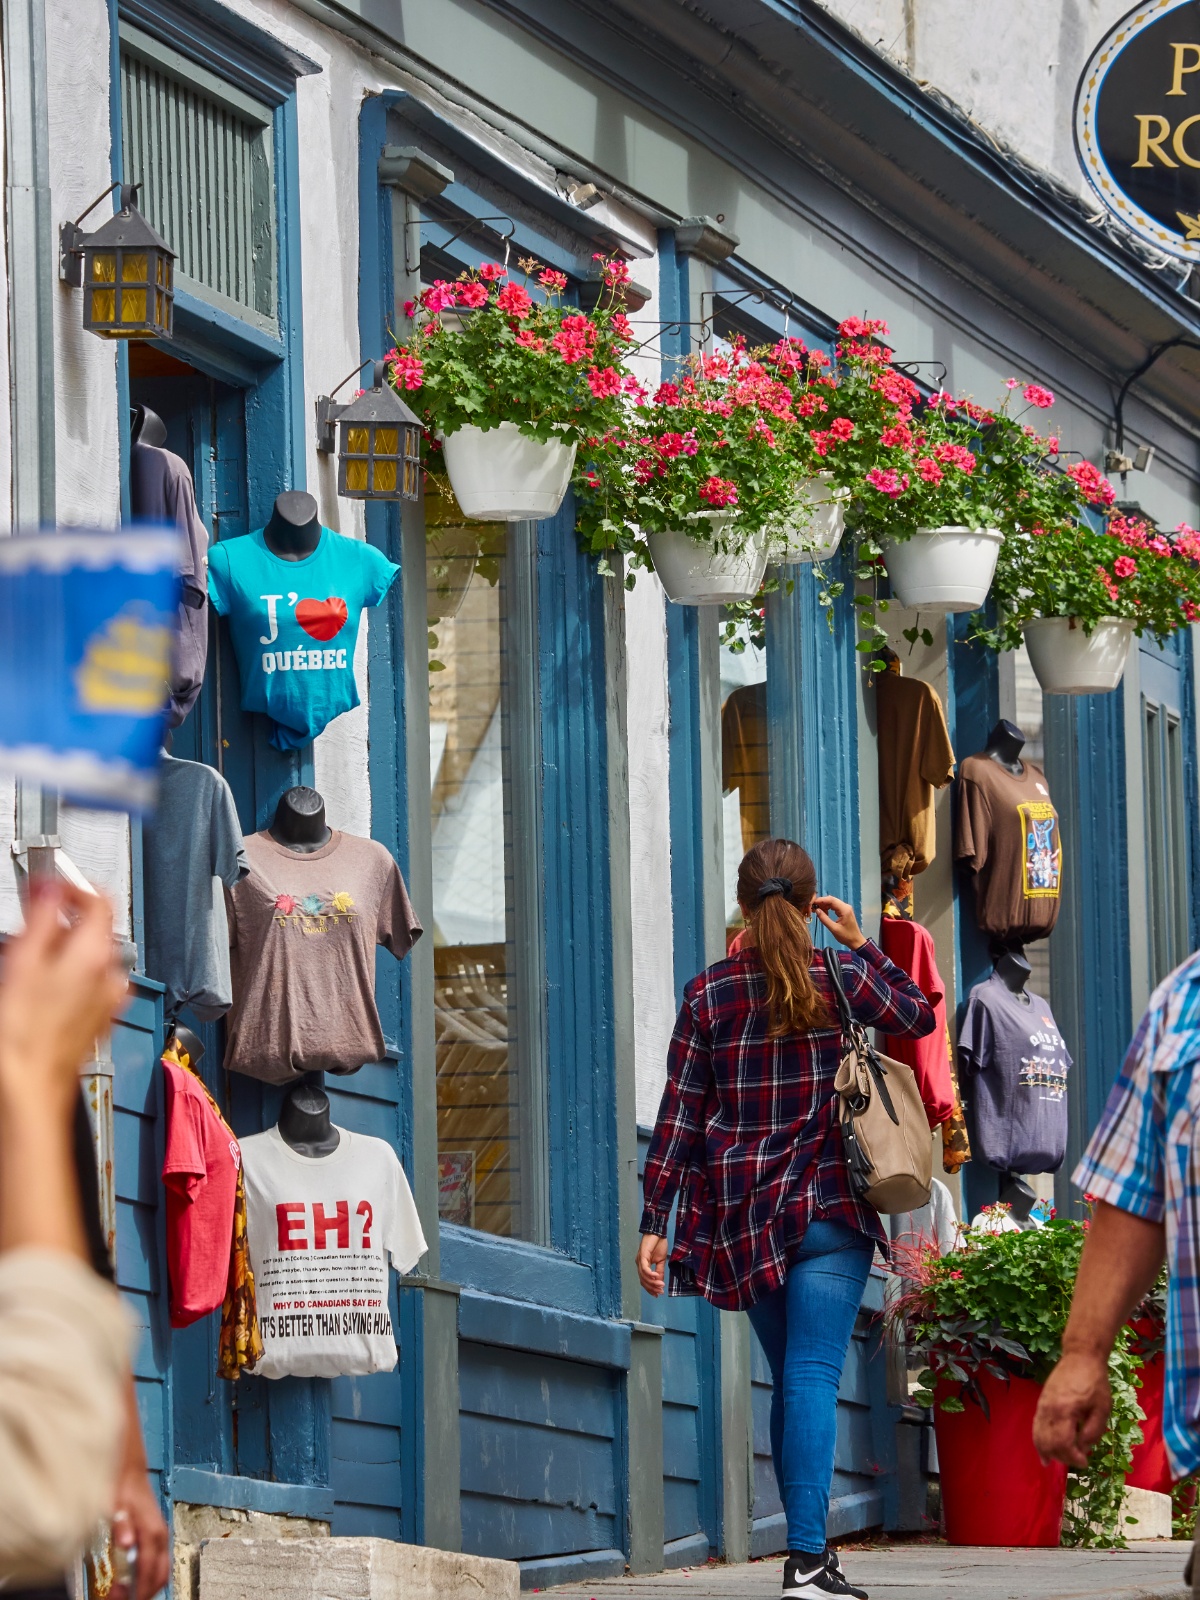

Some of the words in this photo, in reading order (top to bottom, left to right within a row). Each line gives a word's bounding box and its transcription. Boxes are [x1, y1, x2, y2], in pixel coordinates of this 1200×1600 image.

[262, 644, 347, 675] QUÉBEC
[276, 1200, 373, 1251] EH?
[273, 1301, 292, 1310] WHY
[293, 1300, 306, 1309] DO
[307, 1298, 351, 1308] CANADIANS
[352, 1298, 366, 1307] SAY
[367, 1299, 382, 1307] EH?
[260, 1315, 276, 1340] IT'S
[278, 1314, 315, 1338] BETTER
[316, 1313, 341, 1336] THAN
[342, 1311, 372, 1336] SAYING
